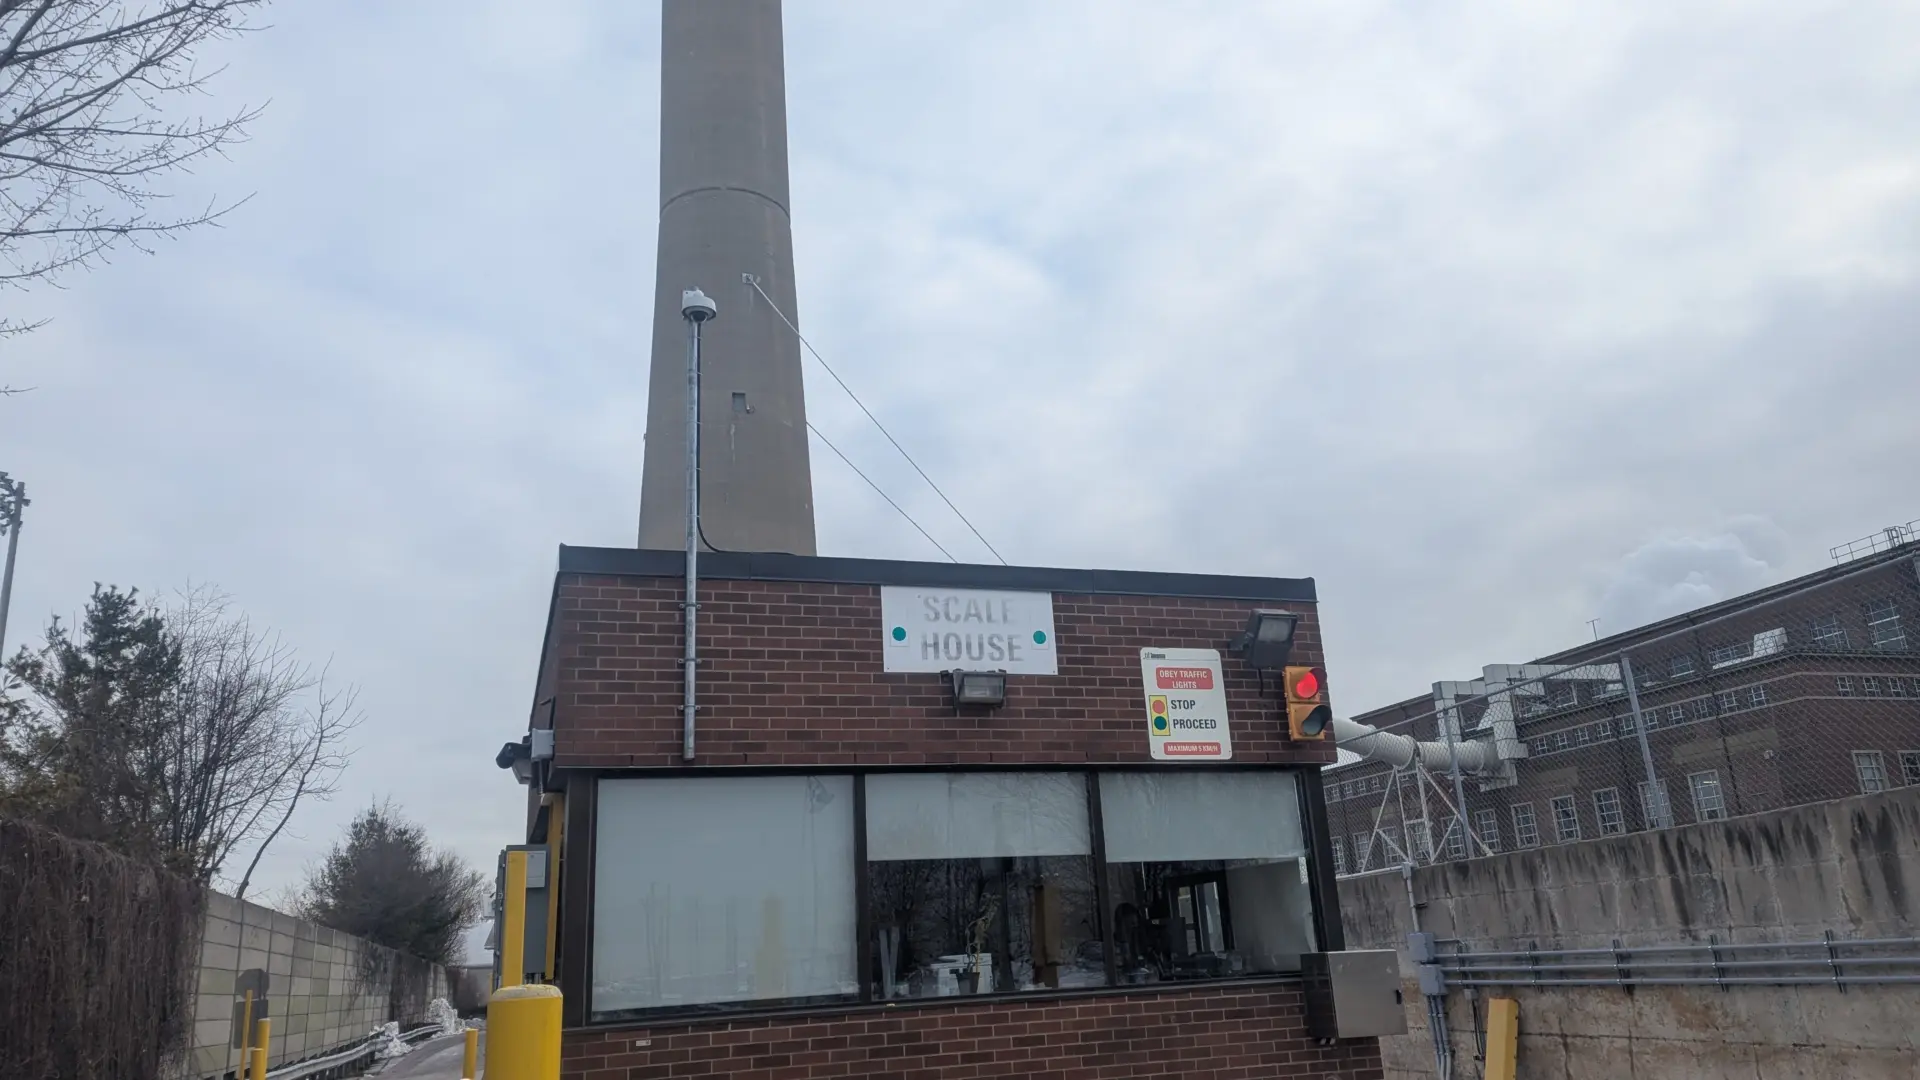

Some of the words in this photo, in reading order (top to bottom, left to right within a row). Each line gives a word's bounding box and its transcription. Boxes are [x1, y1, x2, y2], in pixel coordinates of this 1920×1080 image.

[922, 595, 1017, 625] SCALE
[920, 631, 1025, 662] HOUSE
[1159, 669, 1178, 678] OBEY
[1180, 670, 1208, 679] TRAFFIC
[1172, 681, 1197, 689] LIGHTS
[1170, 699, 1196, 710] STOP
[1172, 718, 1217, 729] PROCEED
